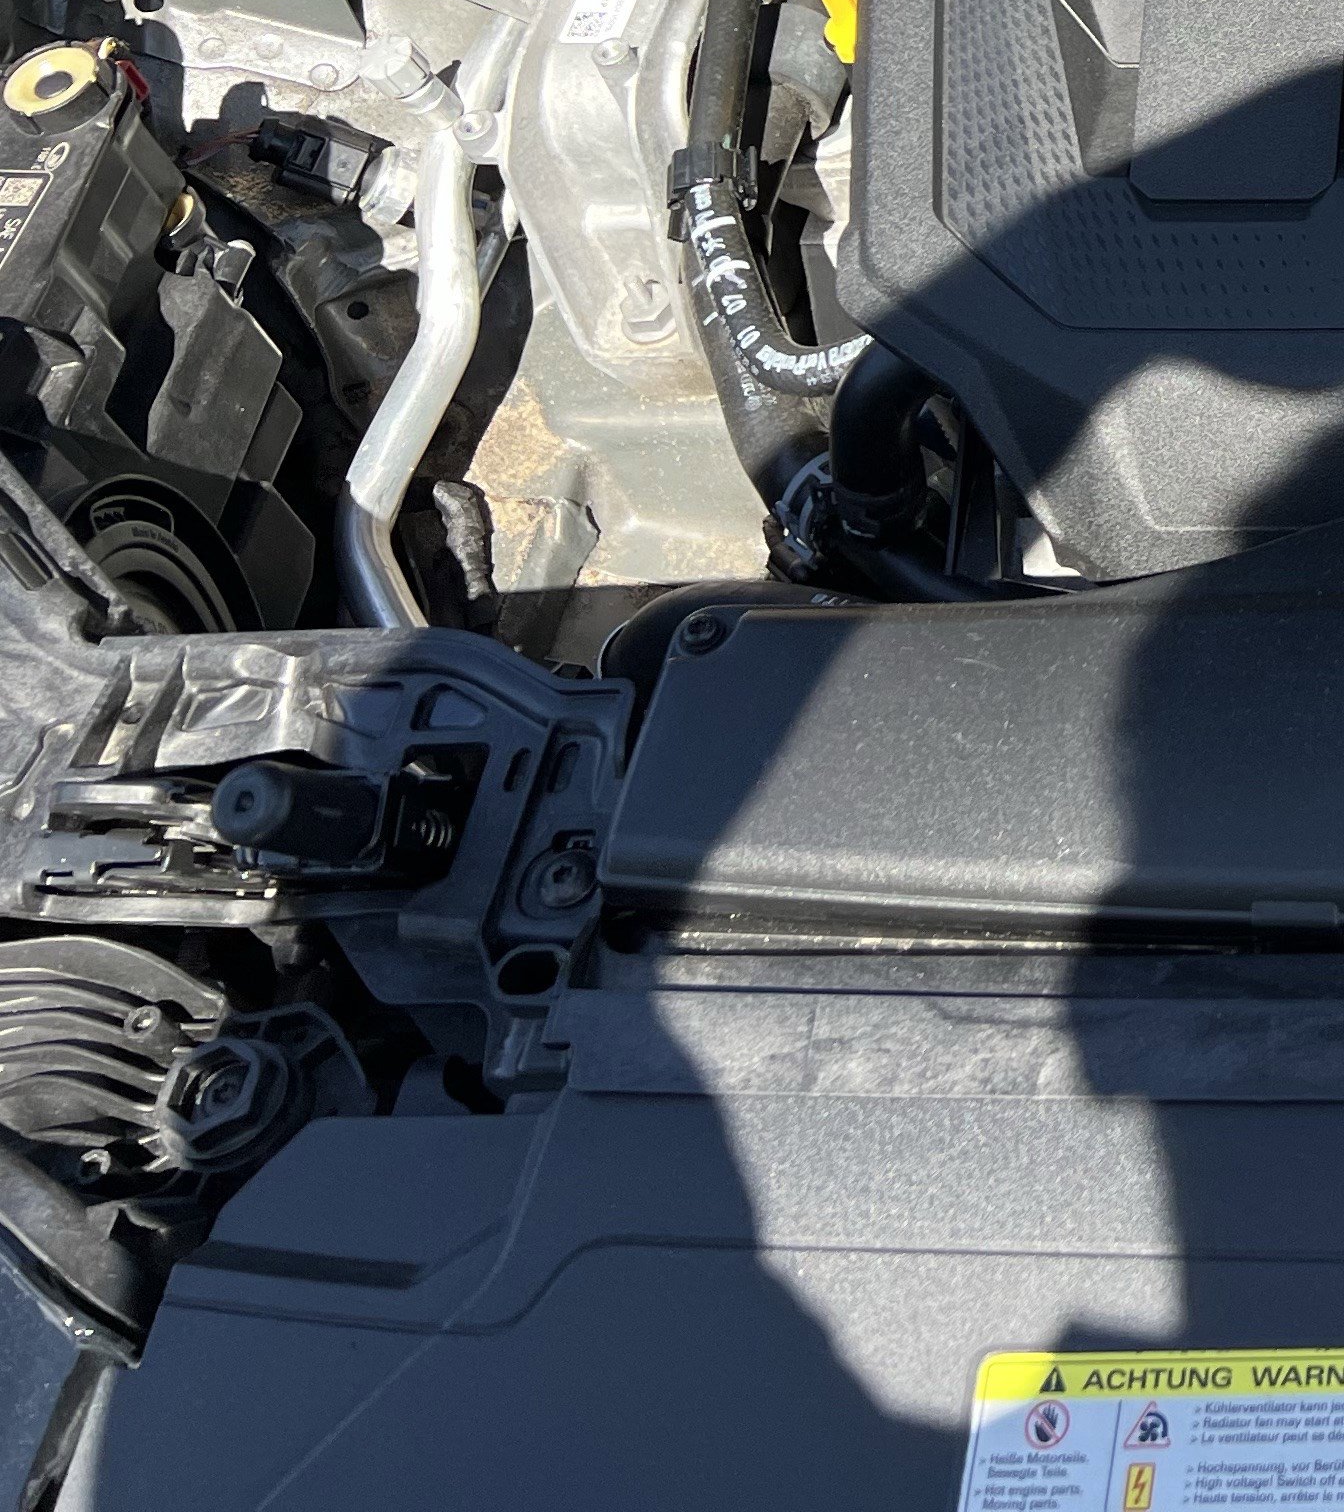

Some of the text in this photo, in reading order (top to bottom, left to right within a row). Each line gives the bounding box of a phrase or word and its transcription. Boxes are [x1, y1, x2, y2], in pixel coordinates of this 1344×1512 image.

[1082, 1367, 1233, 1392] ACHTUNG
[1205, 1401, 1297, 1414] Kühlerventilator
[1300, 1401, 1327, 1412] kann
[1203, 1415, 1251, 1428] Radiator
[1255, 1415, 1271, 1427] fan
[1275, 1417, 1301, 1429] may
[1304, 1415, 1330, 1427] start
[1333, 1416, 1344, 1426] at
[1201, 1433, 1214, 1443] Le
[1218, 1431, 1280, 1443] ventilateur
[1282, 1431, 1308, 1445] peut
[1311, 1432, 1324, 1442] se
[1197, 1461, 1287, 1475] Hochspannung,
[1291, 1462, 1310, 1472] vor
[1195, 1476, 1222, 1491] High
[1277, 1474, 1317, 1486] Switch
[1319, 1474, 1336, 1486] off
[1193, 1492, 1227, 1504] Haute
[1322, 1491, 1333, 1502] le
